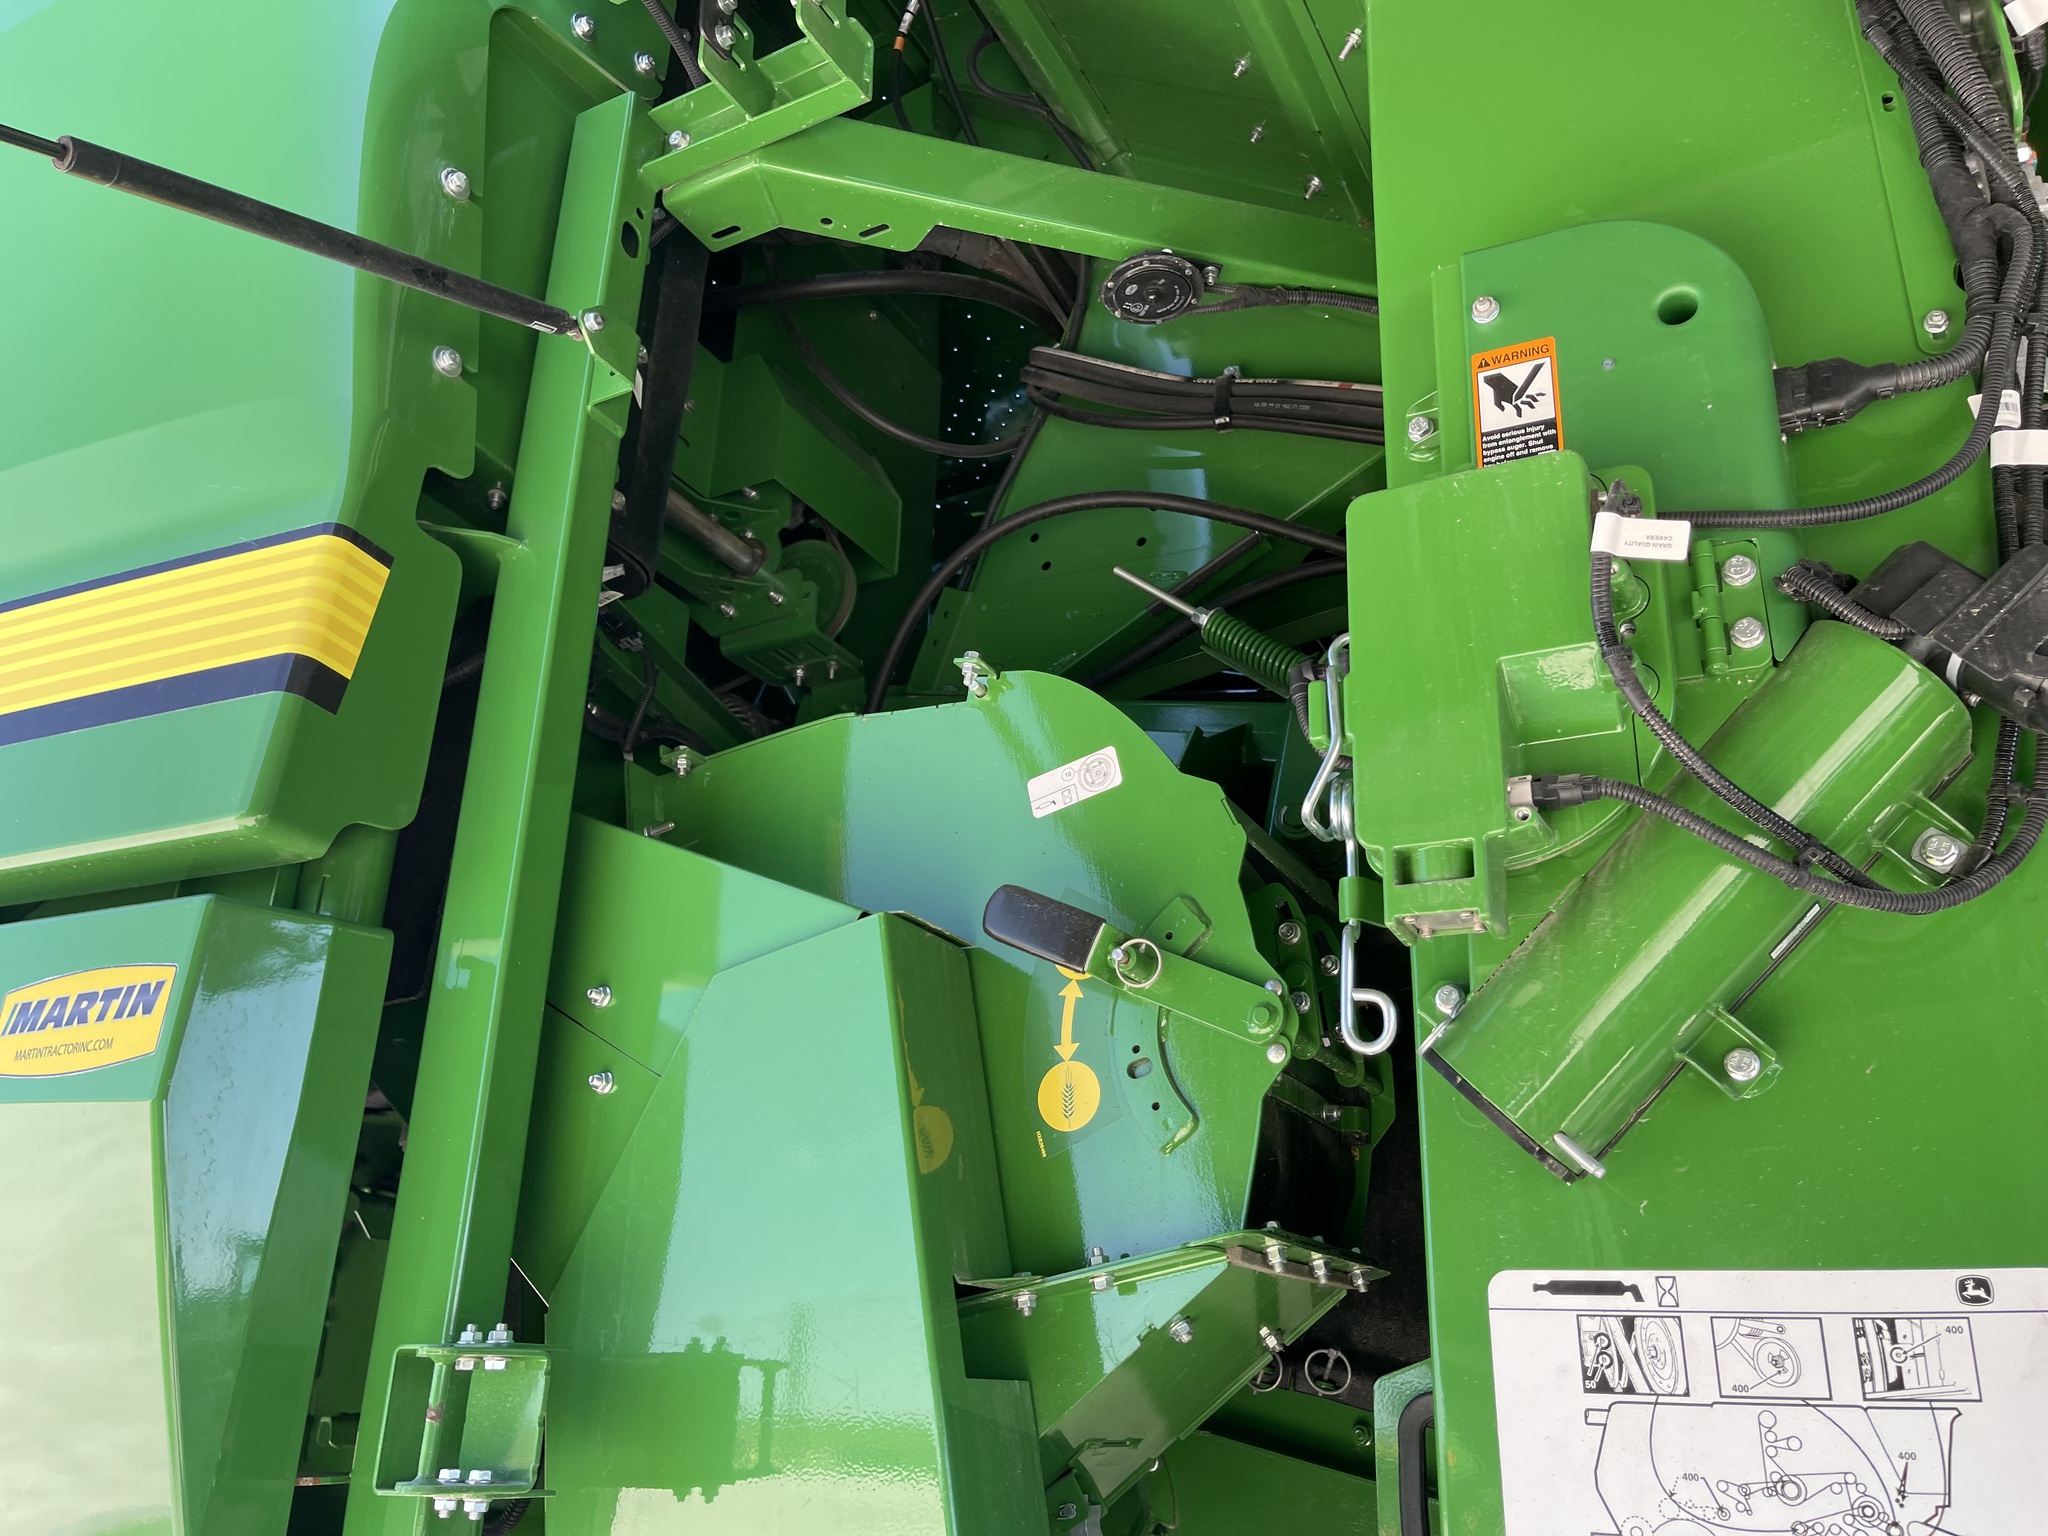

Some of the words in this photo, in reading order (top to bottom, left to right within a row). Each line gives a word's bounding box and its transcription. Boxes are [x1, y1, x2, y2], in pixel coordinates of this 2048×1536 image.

[1491, 344, 1550, 365] WARNING
[1482, 433, 1501, 442] Avoid
[1502, 428, 1525, 438] serious
[1526, 424, 1545, 434] injury
[1482, 441, 1498, 449] from
[1499, 433, 1541, 447] entanglement
[1542, 429, 1557, 437] with
[1483, 446, 1506, 456] bypass
[1507, 443, 1527, 453] auger.
[1528, 438, 1544, 447] Shut
[1483, 454, 1504, 463] engine
[1505, 450, 1515, 458] off
[1516, 448, 1528, 456] and
[1529, 444, 1554, 453] remove
[1624, 540, 1651, 548] QUALITY
[8, 980, 166, 1036] MARTIN
[14, 1037, 114, 1062] MARTINTRACTORINC.COM
[1945, 1325, 1963, 1334] 400
[1585, 1380, 1597, 1389] 50
[1731, 1384, 1749, 1393] 400
[1898, 1452, 1917, 1461] 400
[1682, 1473, 1699, 1482] 400
